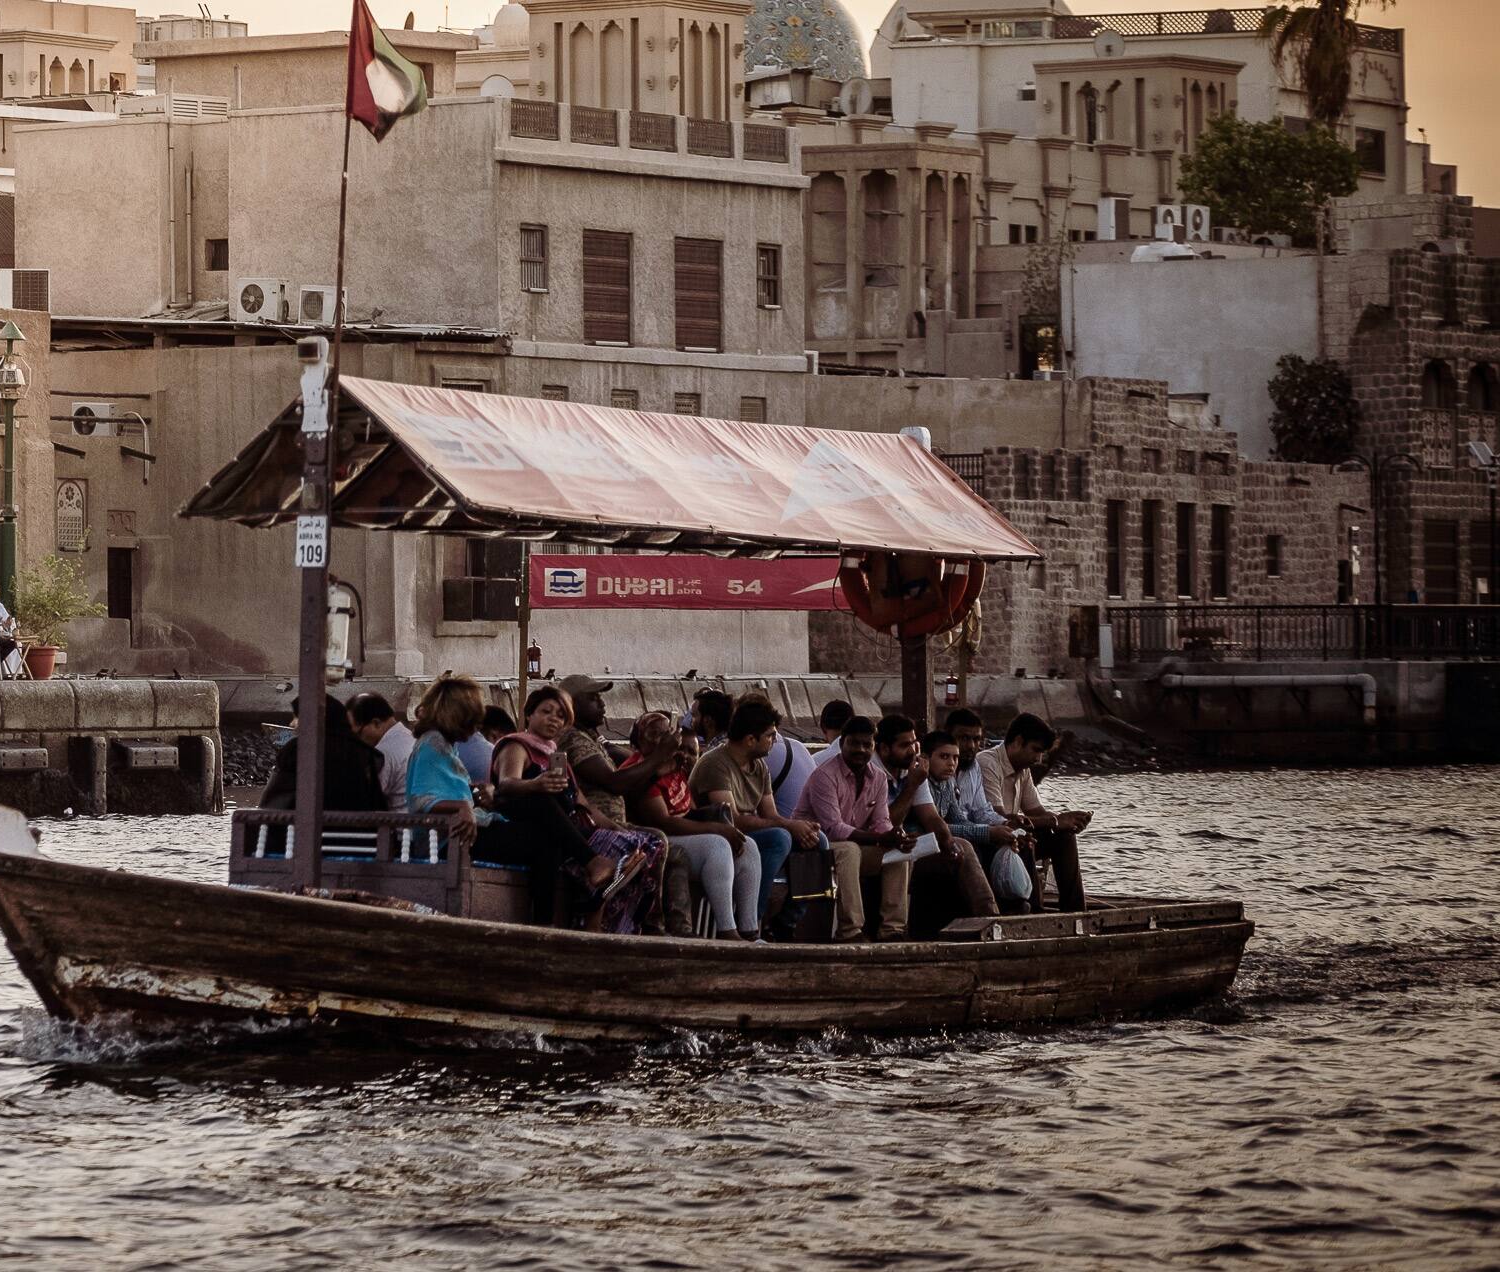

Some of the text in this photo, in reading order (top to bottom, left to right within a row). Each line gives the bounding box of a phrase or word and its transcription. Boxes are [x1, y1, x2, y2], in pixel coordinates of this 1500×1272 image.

[300, 545, 323, 563] 109
[597, 576, 674, 597] DUBAI
[676, 586, 702, 595] abra
[727, 579, 763, 595] 54
